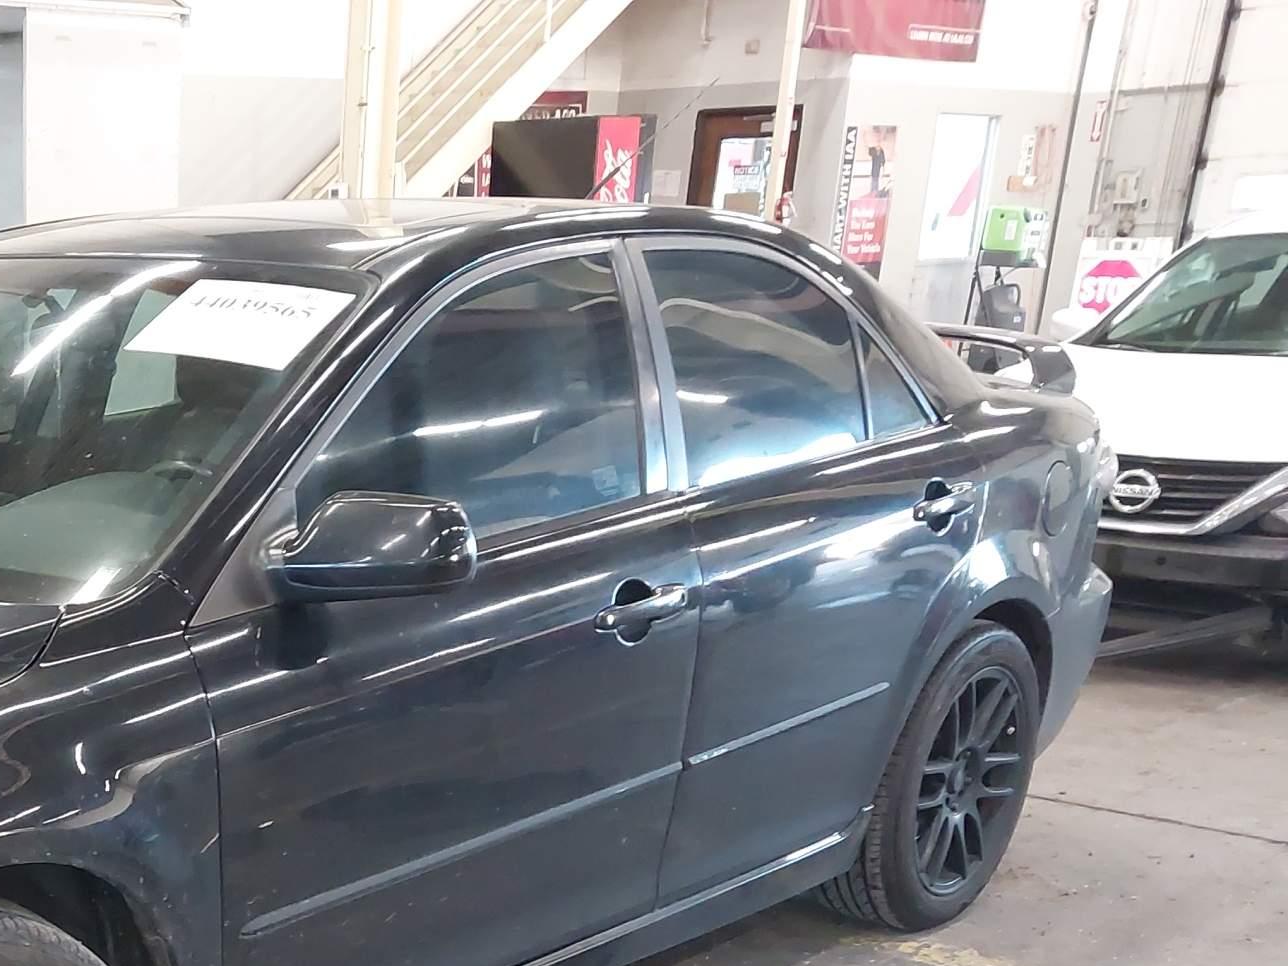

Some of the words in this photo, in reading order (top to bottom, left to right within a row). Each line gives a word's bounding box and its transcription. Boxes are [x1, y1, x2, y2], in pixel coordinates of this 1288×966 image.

[844, 129, 857, 161] IAA
[838, 166, 851, 208] WITH
[192, 296, 317, 318] 44039565
[1113, 486, 1152, 496] NISSAN
